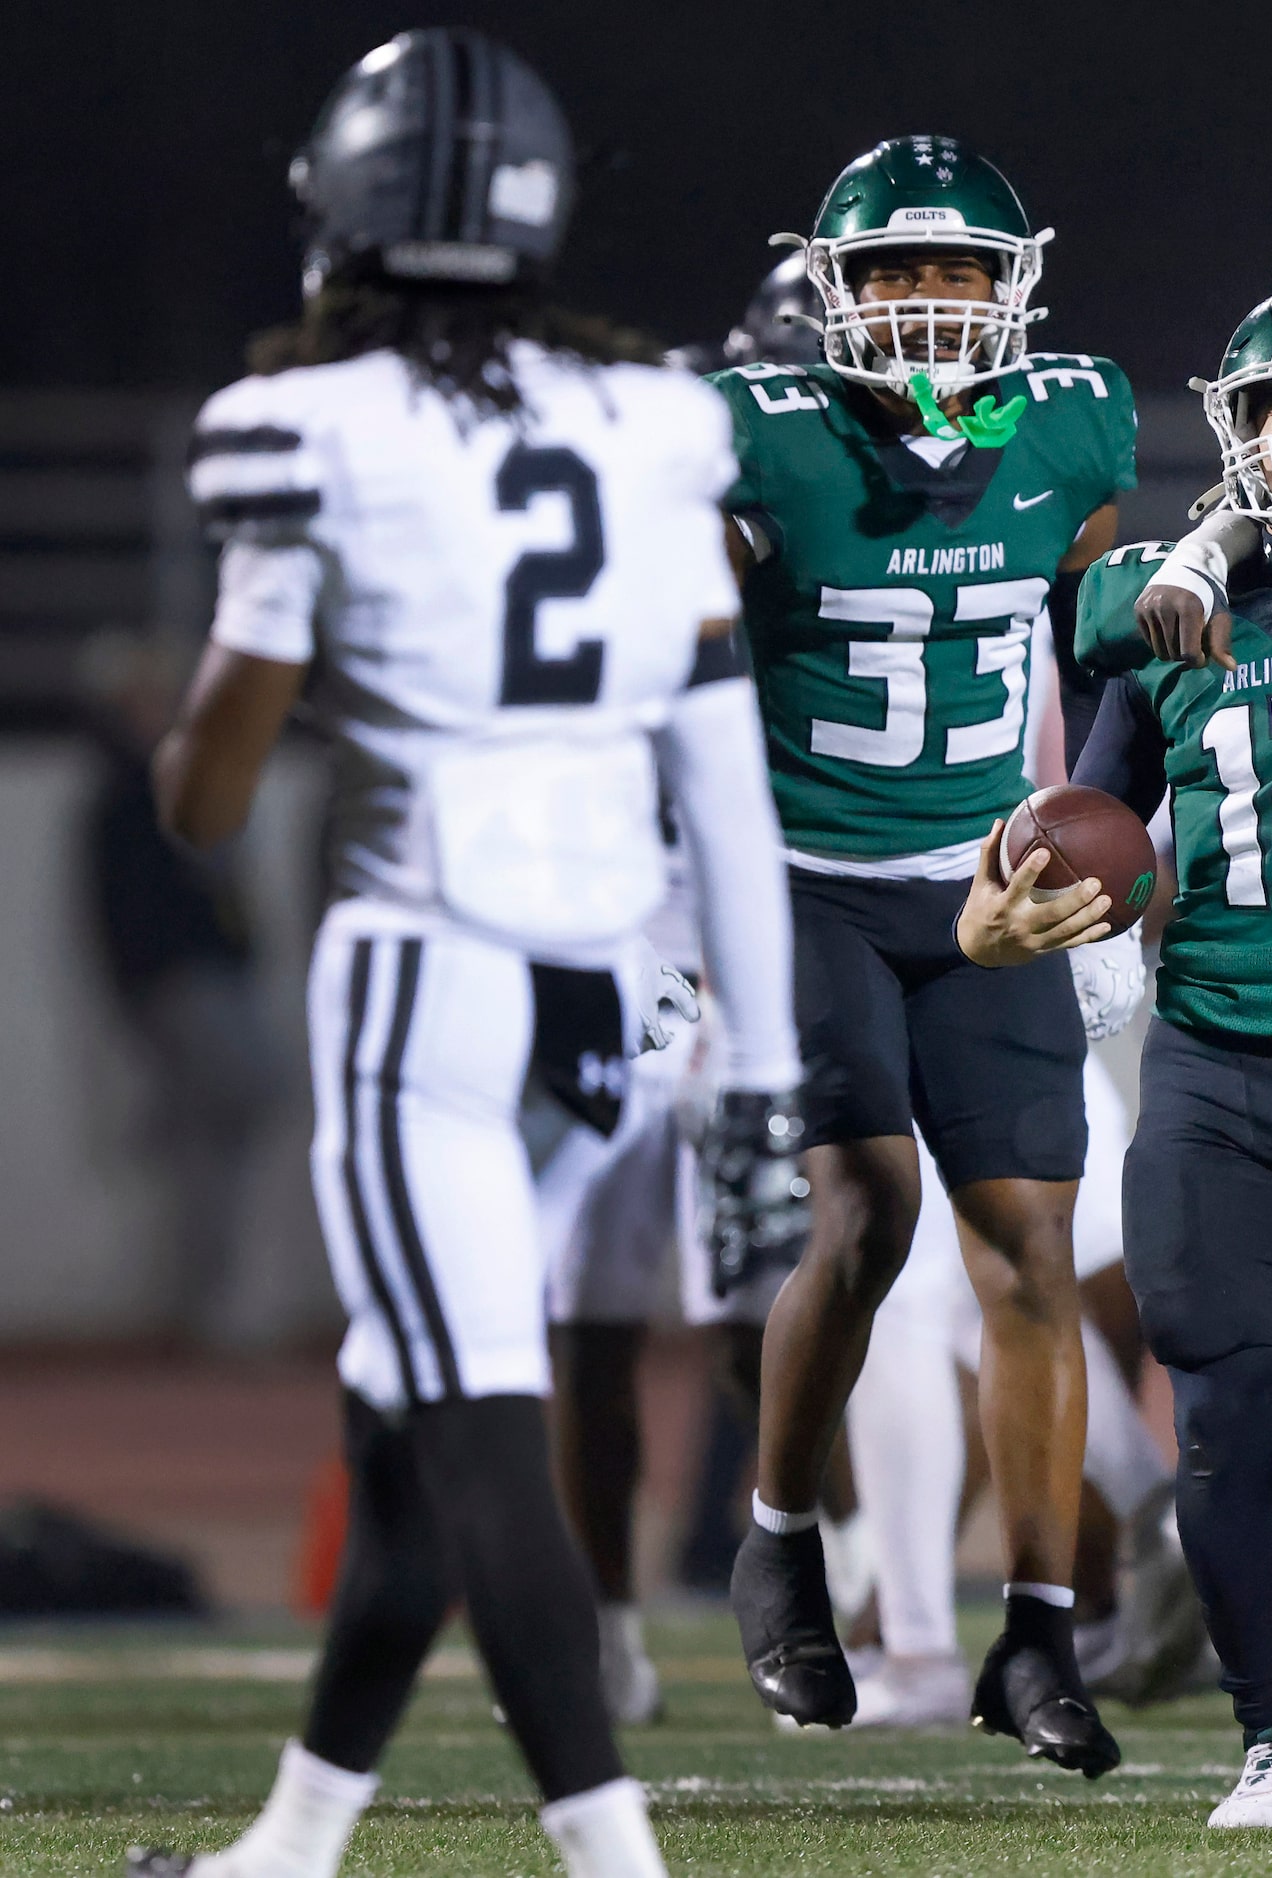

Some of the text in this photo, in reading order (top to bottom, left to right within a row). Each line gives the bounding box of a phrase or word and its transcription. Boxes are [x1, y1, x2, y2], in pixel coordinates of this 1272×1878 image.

[905, 211, 946, 221] COLTS
[496, 447, 605, 706] 2
[885, 542, 1005, 575] ARLINGTON
[811, 577, 1050, 767] 33
